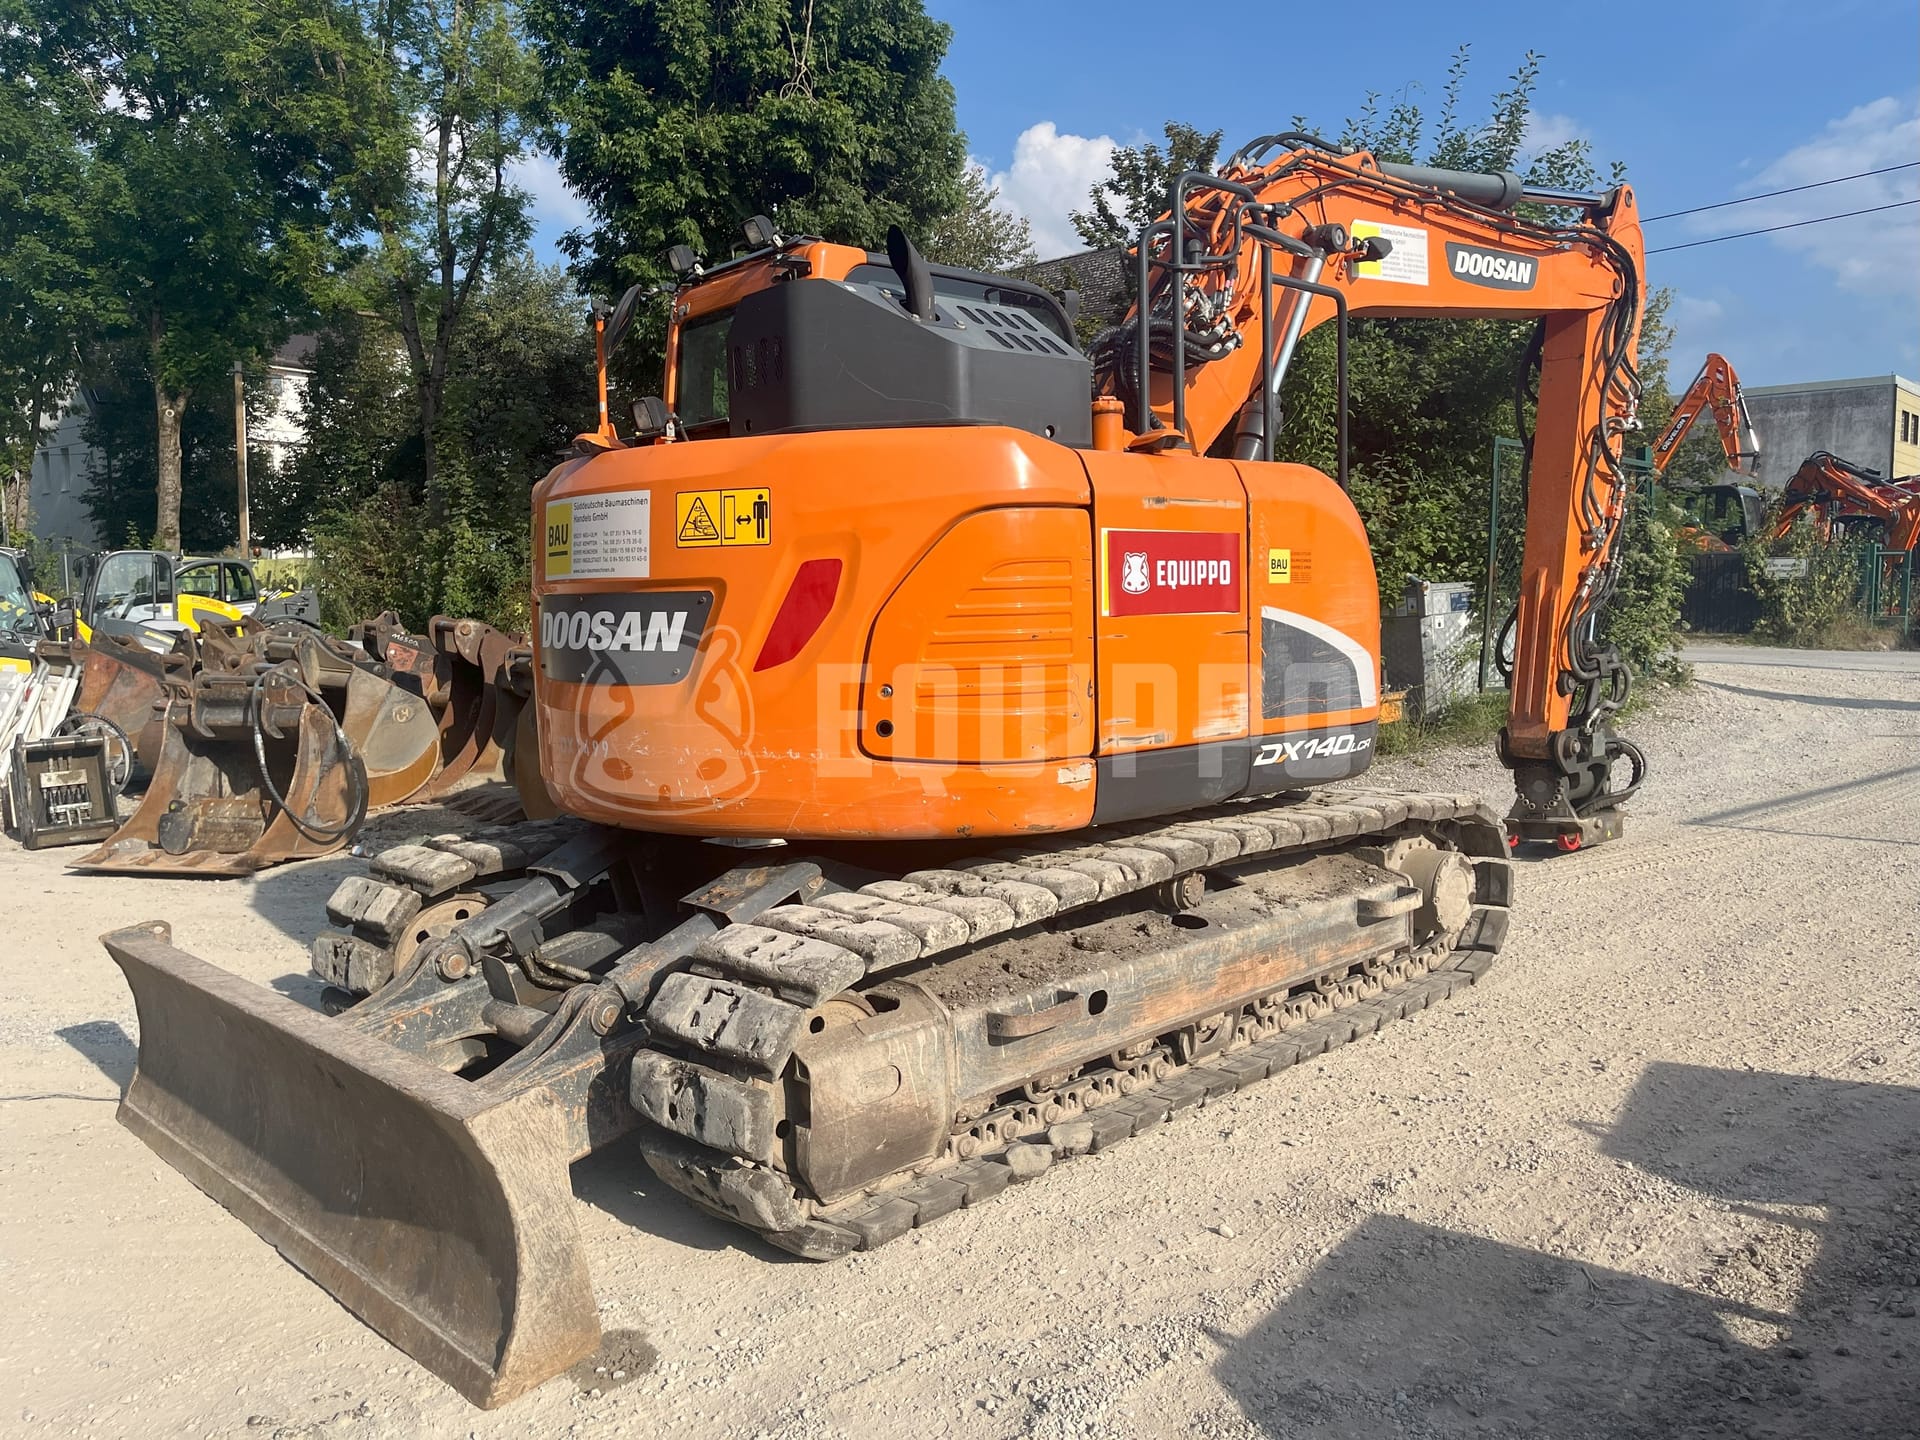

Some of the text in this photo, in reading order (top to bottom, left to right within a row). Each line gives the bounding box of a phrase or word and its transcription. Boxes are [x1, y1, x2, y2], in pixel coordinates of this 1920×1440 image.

[1455, 251, 1532, 284] DOOSAN
[605, 497, 648, 508] Baumaschinen
[592, 512, 608, 521] GmbH
[549, 524, 568, 547] BAU
[1156, 560, 1231, 590] EQUIPPO
[1271, 559, 1288, 570] BAU
[542, 610, 688, 652] DOOSAN
